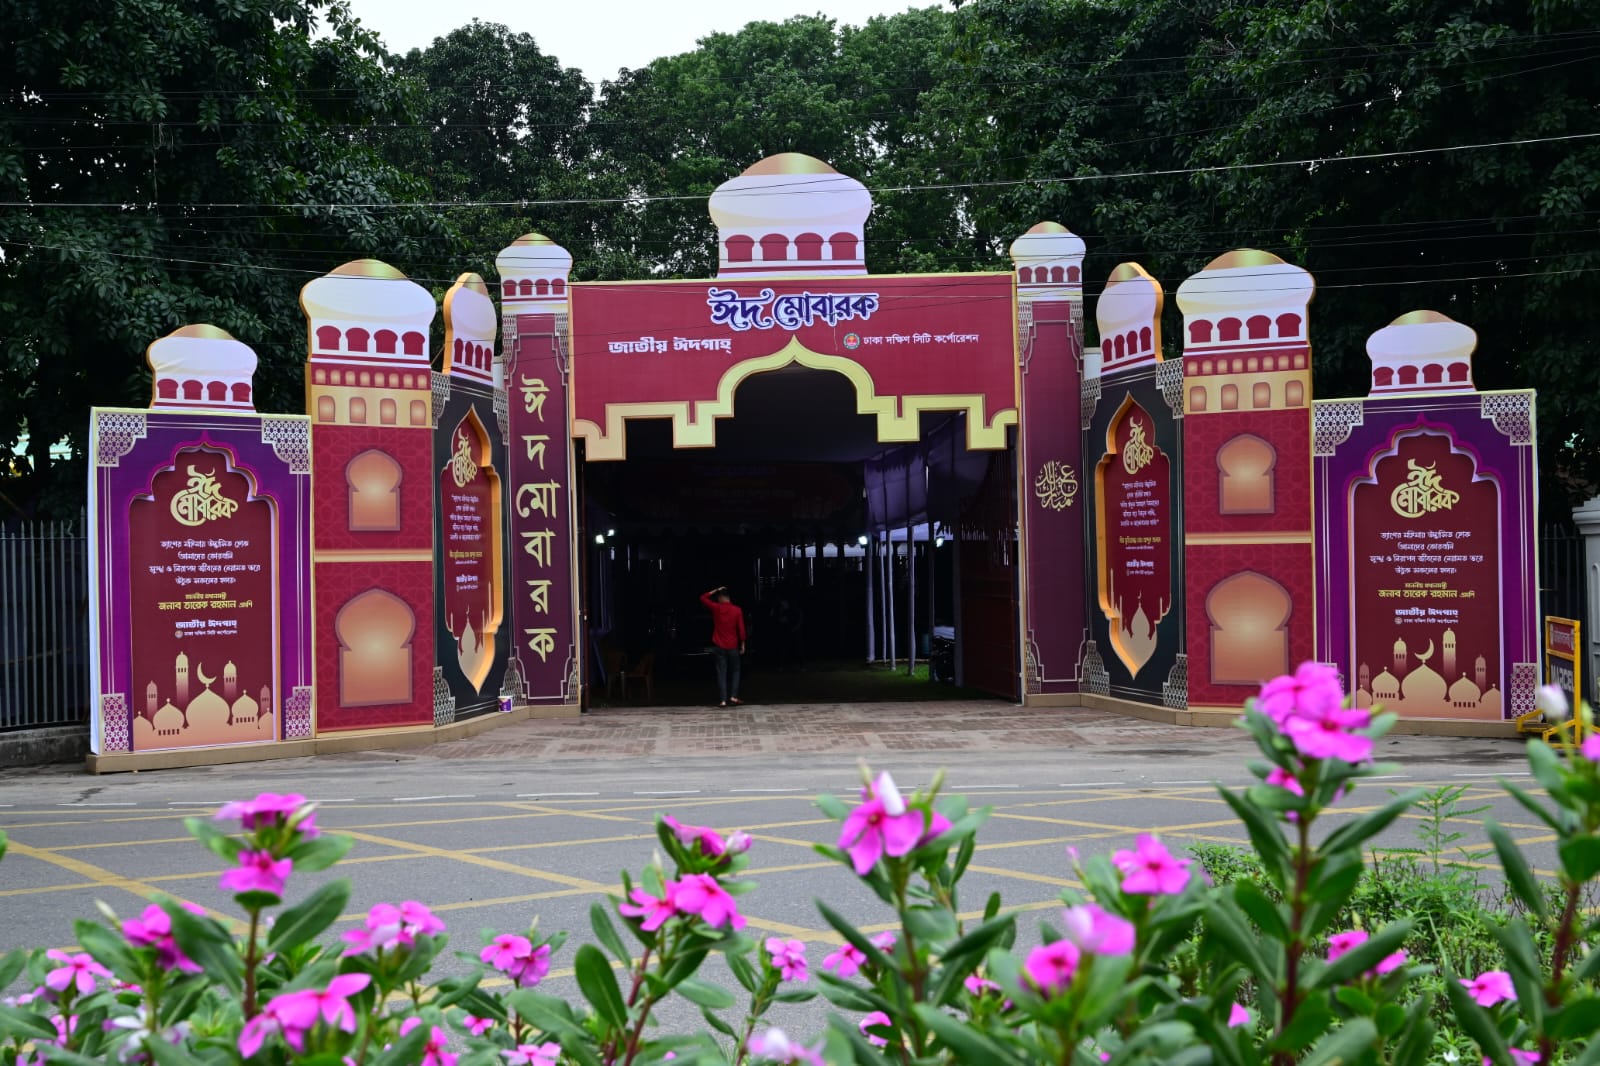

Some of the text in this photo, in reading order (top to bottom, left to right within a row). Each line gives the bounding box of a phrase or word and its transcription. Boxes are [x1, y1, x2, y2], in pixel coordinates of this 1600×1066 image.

[707, 287, 879, 331] ঈদ মোবারক
[608, 337, 732, 354] জাতীয় ঈদগাহ্
[863, 332, 979, 345] ঢাকা দক্ষিণ সিটি কর্পোরেশন
[187, 465, 224, 501] ঈদ
[1407, 458, 1443, 493] ঈদ
[170, 489, 239, 526] মোবারক
[1391, 482, 1460, 518] মোবারক
